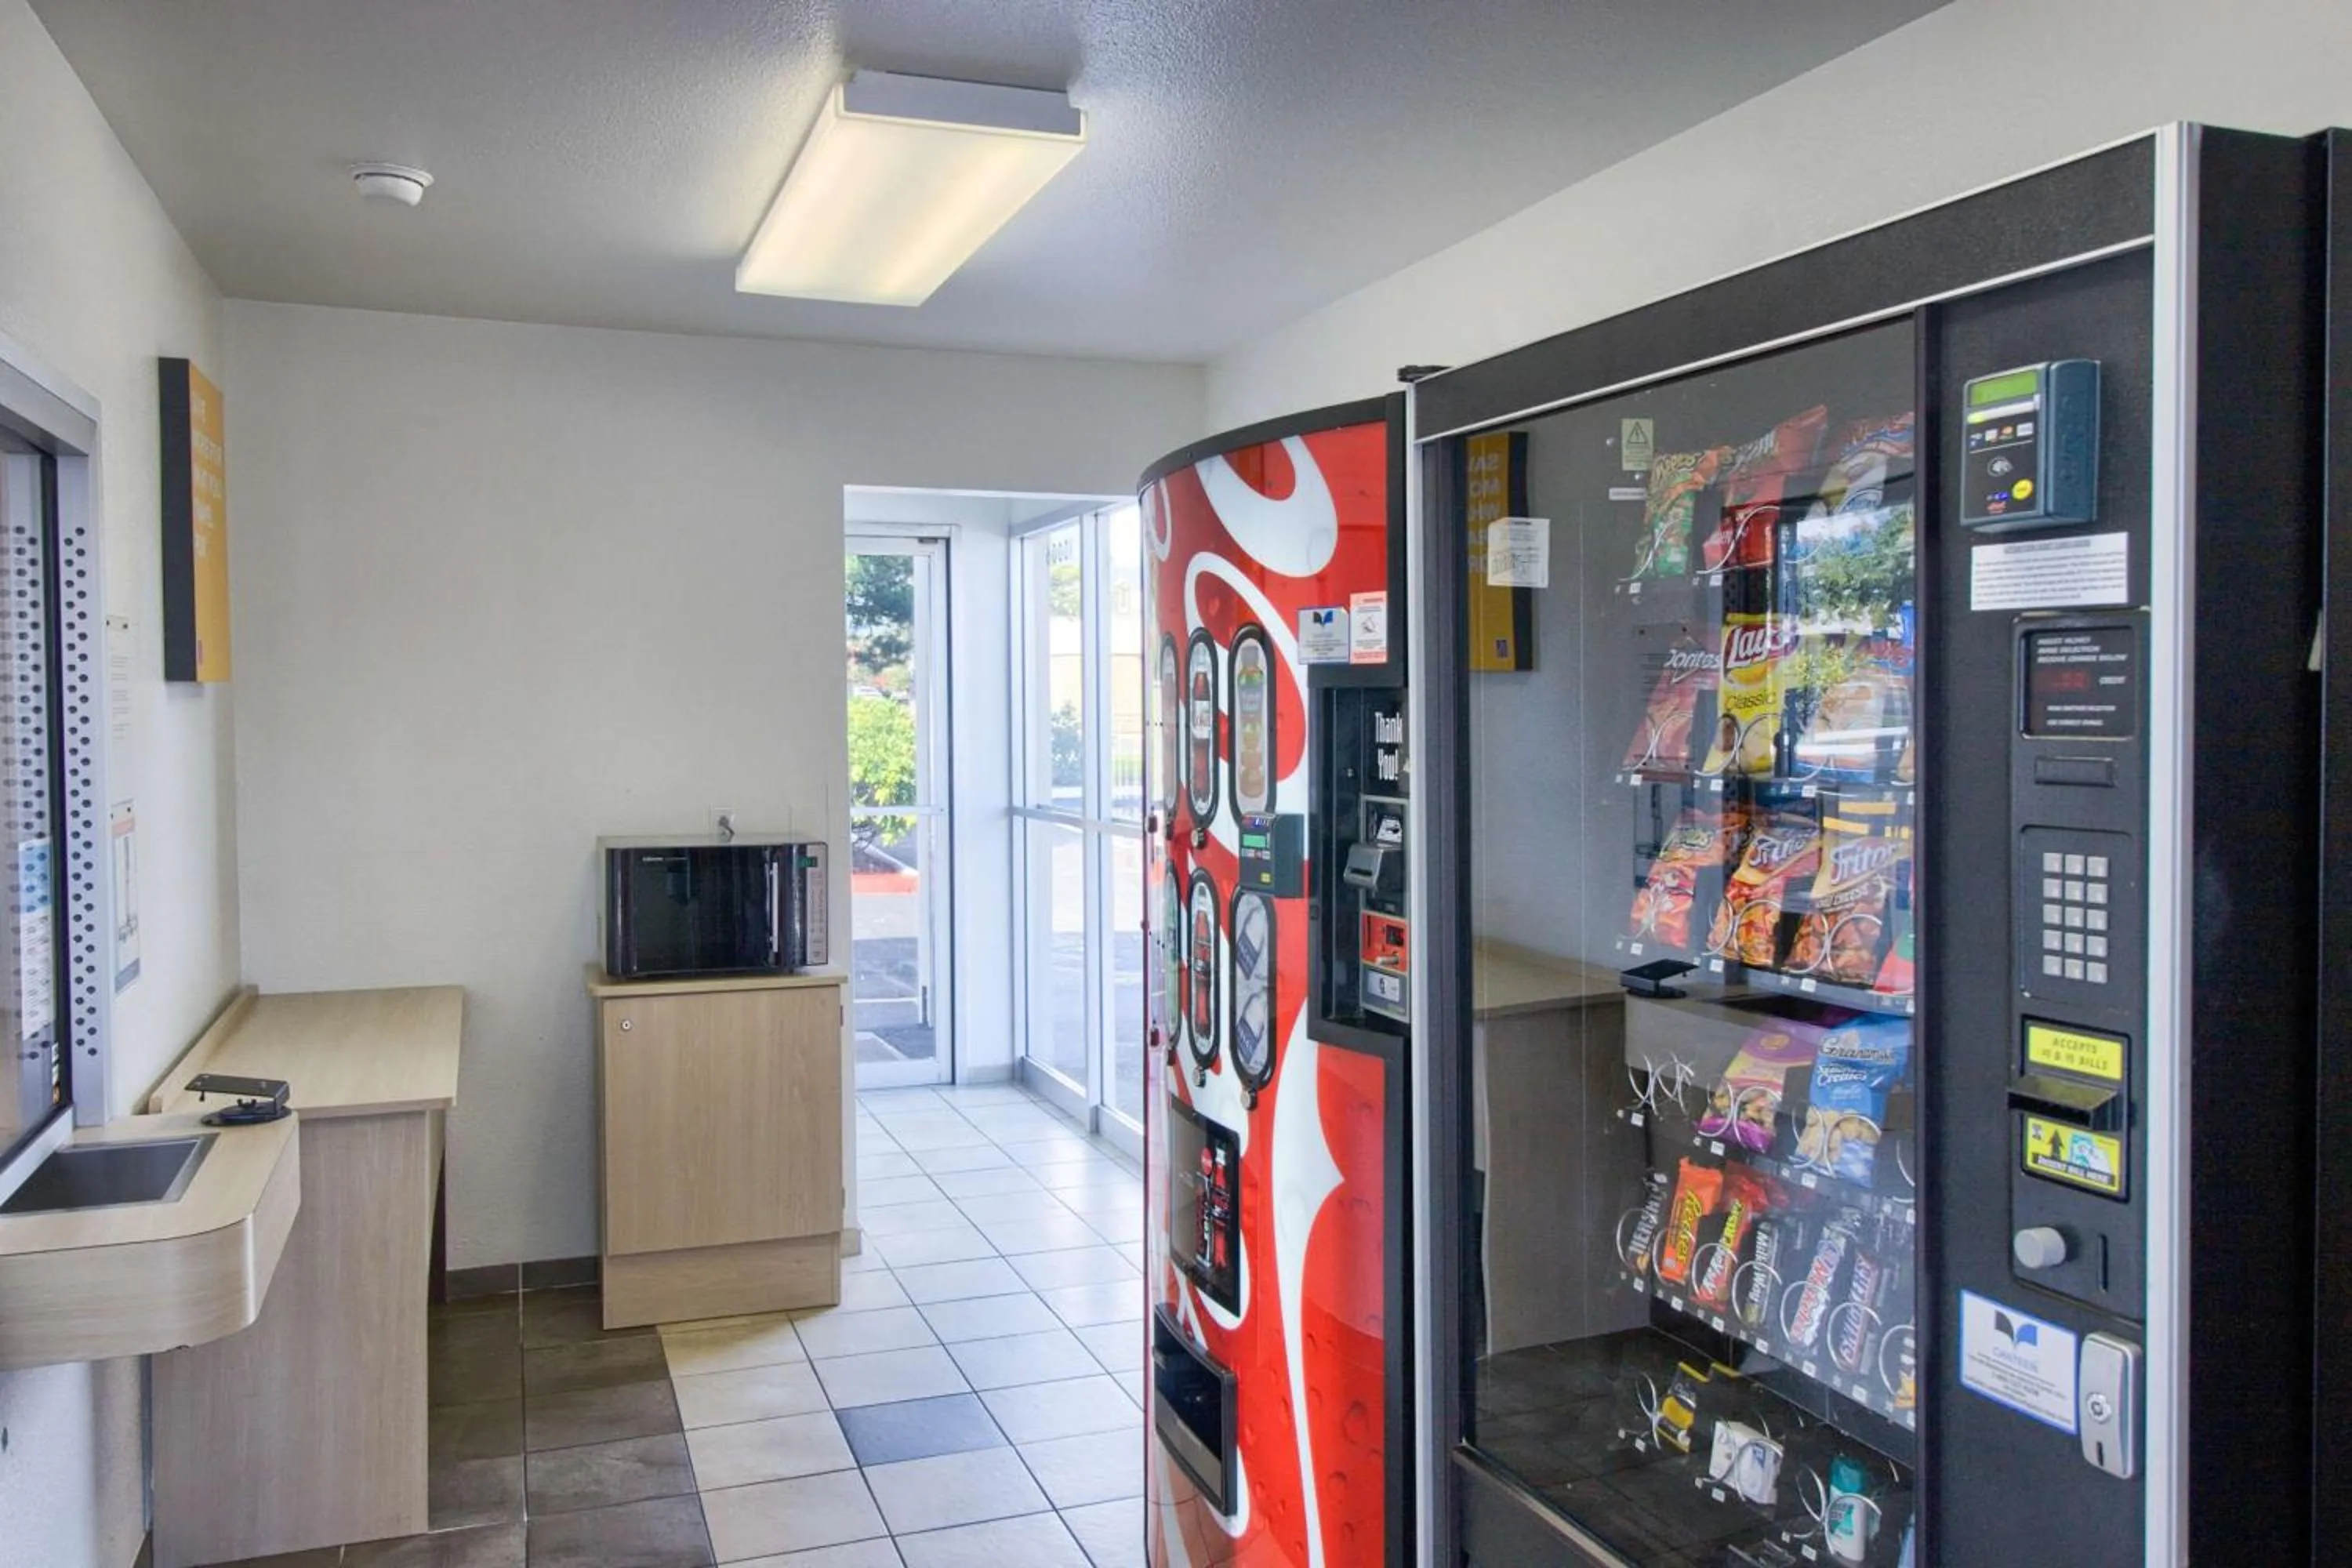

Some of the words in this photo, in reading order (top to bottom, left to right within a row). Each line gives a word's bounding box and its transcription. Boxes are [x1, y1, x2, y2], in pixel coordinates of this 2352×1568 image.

[1374, 711, 1403, 743] Thank
[1377, 748, 1399, 781] You!
[2052, 1037, 2098, 1054] ACCEPTS
[2079, 1055, 2109, 1070] BILLS
